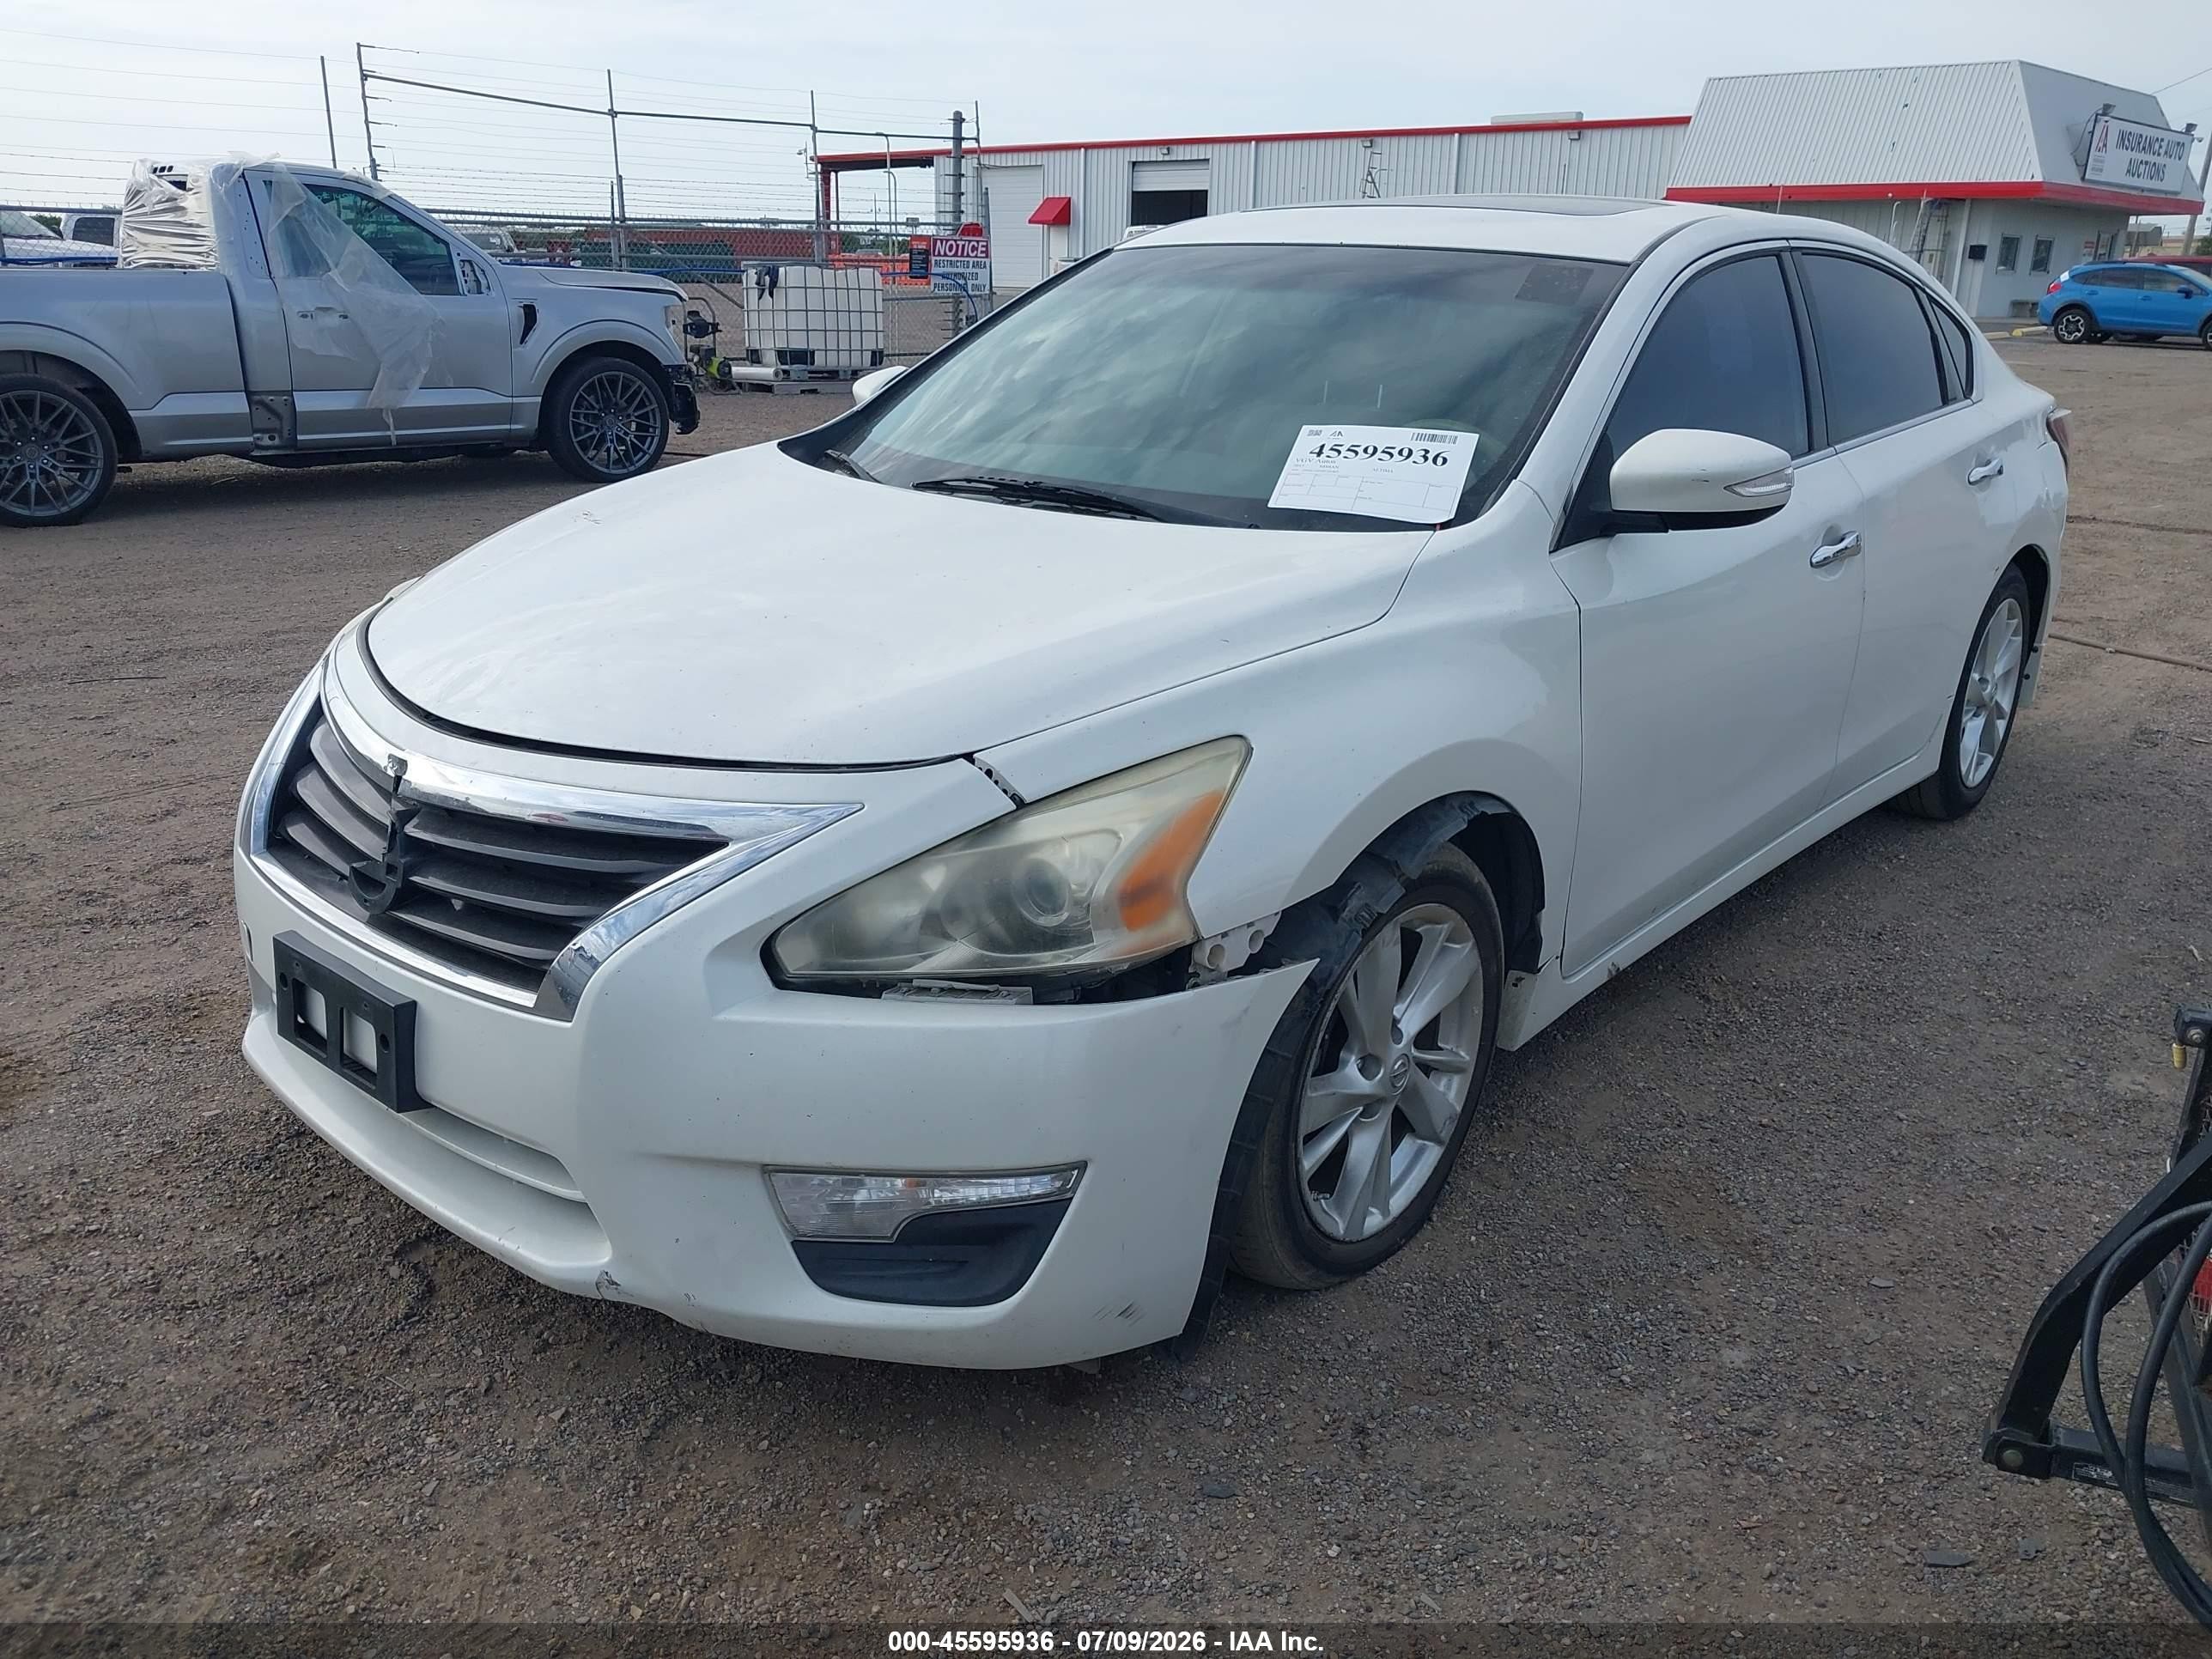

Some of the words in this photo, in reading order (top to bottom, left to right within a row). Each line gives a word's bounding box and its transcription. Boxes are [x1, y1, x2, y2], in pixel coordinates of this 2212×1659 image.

[2116, 129, 2163, 157] INSURANCE
[2163, 140, 2185, 161] AUTO
[2125, 157, 2166, 182] AUCTIONS
[934, 240, 987, 257] NOTICE
[933, 259, 970, 269] RESTRICTED
[971, 260, 987, 270] AREA
[933, 283, 968, 292] PERSONN
[971, 283, 987, 292] ONLY
[1309, 443, 1450, 467] 45595936
